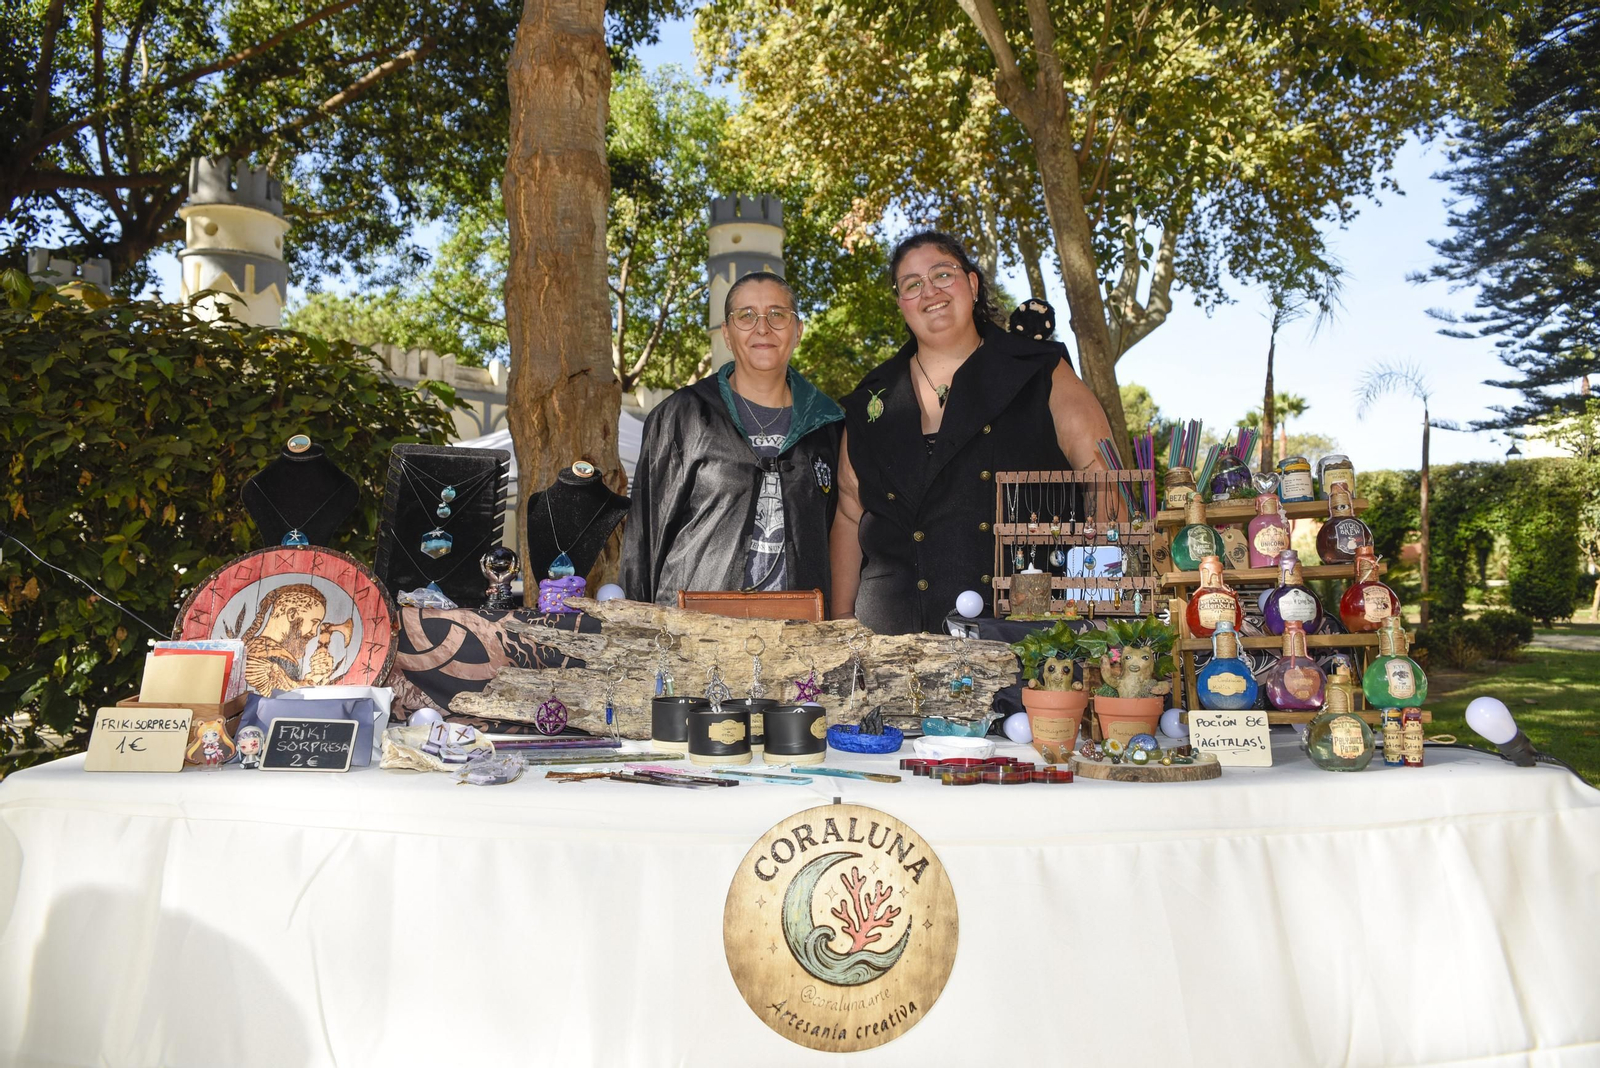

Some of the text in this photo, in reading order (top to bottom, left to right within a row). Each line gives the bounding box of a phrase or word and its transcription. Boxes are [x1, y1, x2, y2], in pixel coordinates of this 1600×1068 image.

[1169, 494, 1187, 502] BEZO
[1246, 716, 1266, 727] 8€
[276, 741, 351, 753] SORPRESA
[754, 817, 930, 885] CORALUNA
[766, 999, 918, 1040] Artesanía creativa
